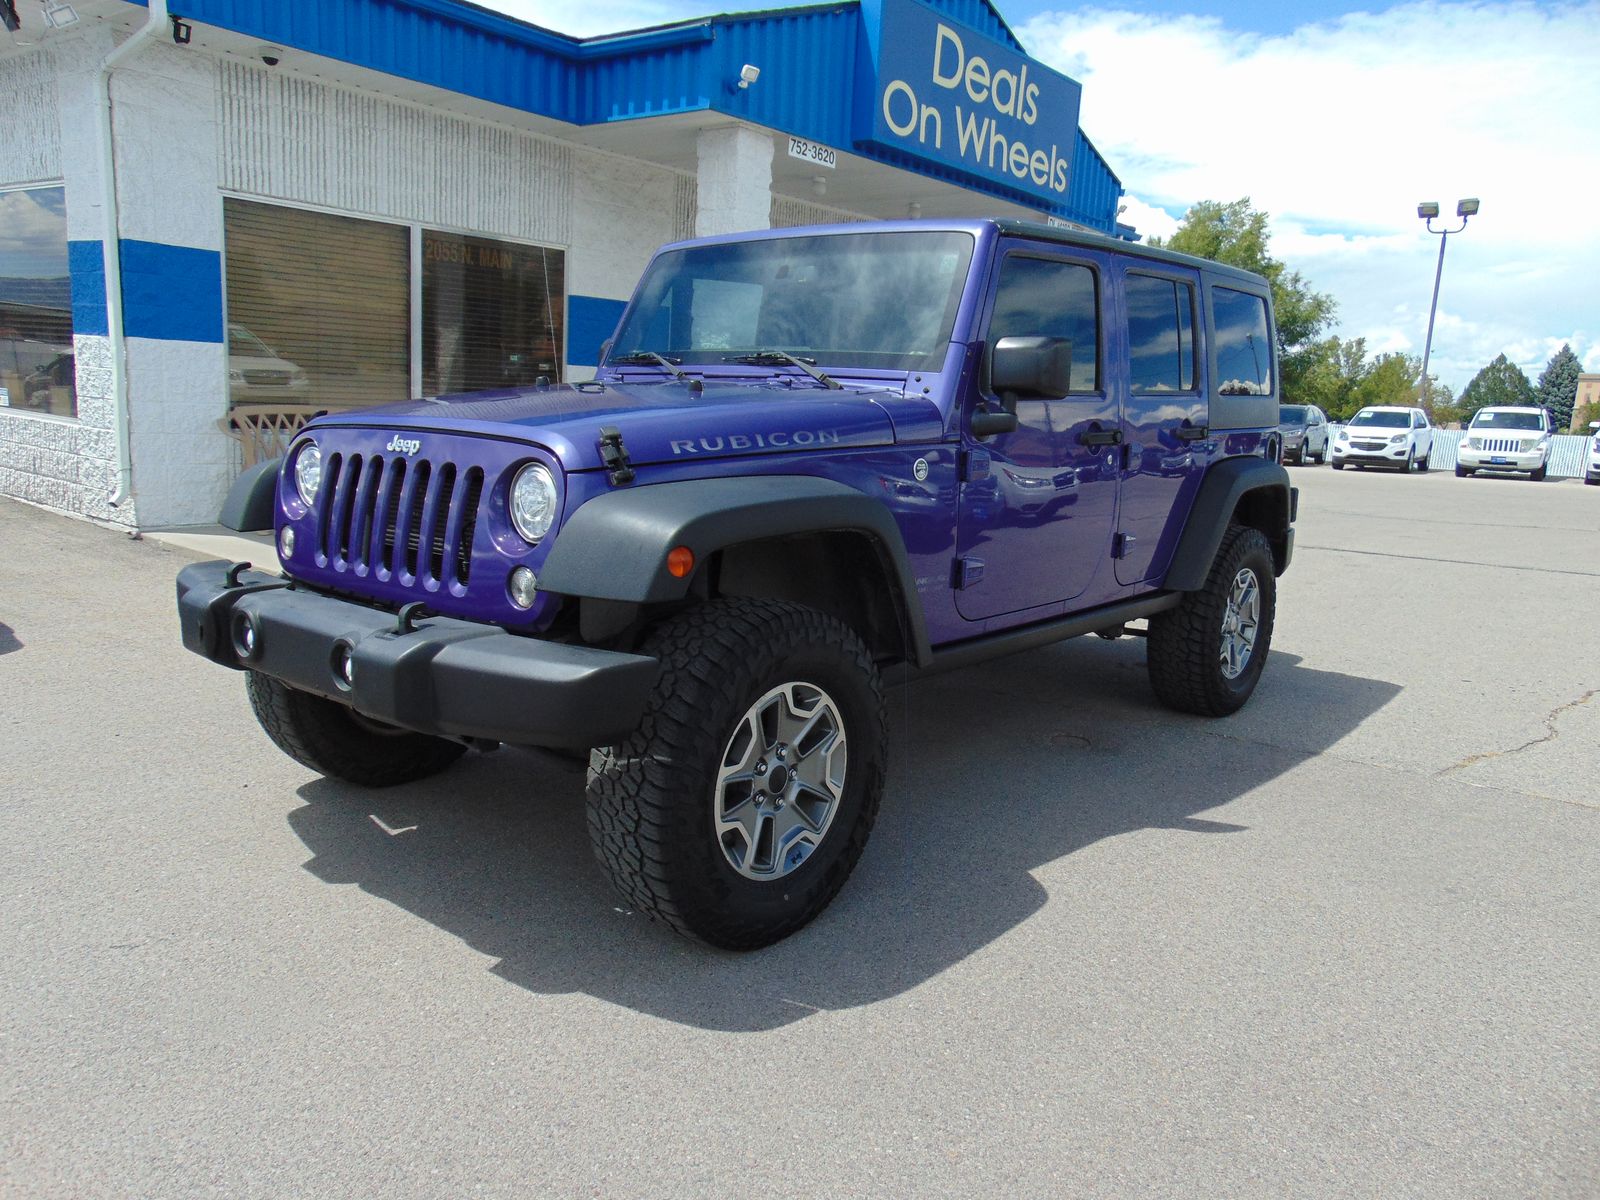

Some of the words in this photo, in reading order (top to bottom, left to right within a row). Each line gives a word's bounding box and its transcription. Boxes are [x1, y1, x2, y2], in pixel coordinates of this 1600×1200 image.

[932, 23, 1039, 125] Deals
[883, 80, 942, 149] On
[956, 106, 1068, 193] Wheels
[790, 138, 835, 165] 752-3620
[480, 248, 512, 269] MAIN
[387, 434, 420, 457] Jeep
[670, 430, 840, 454] RUBICON
